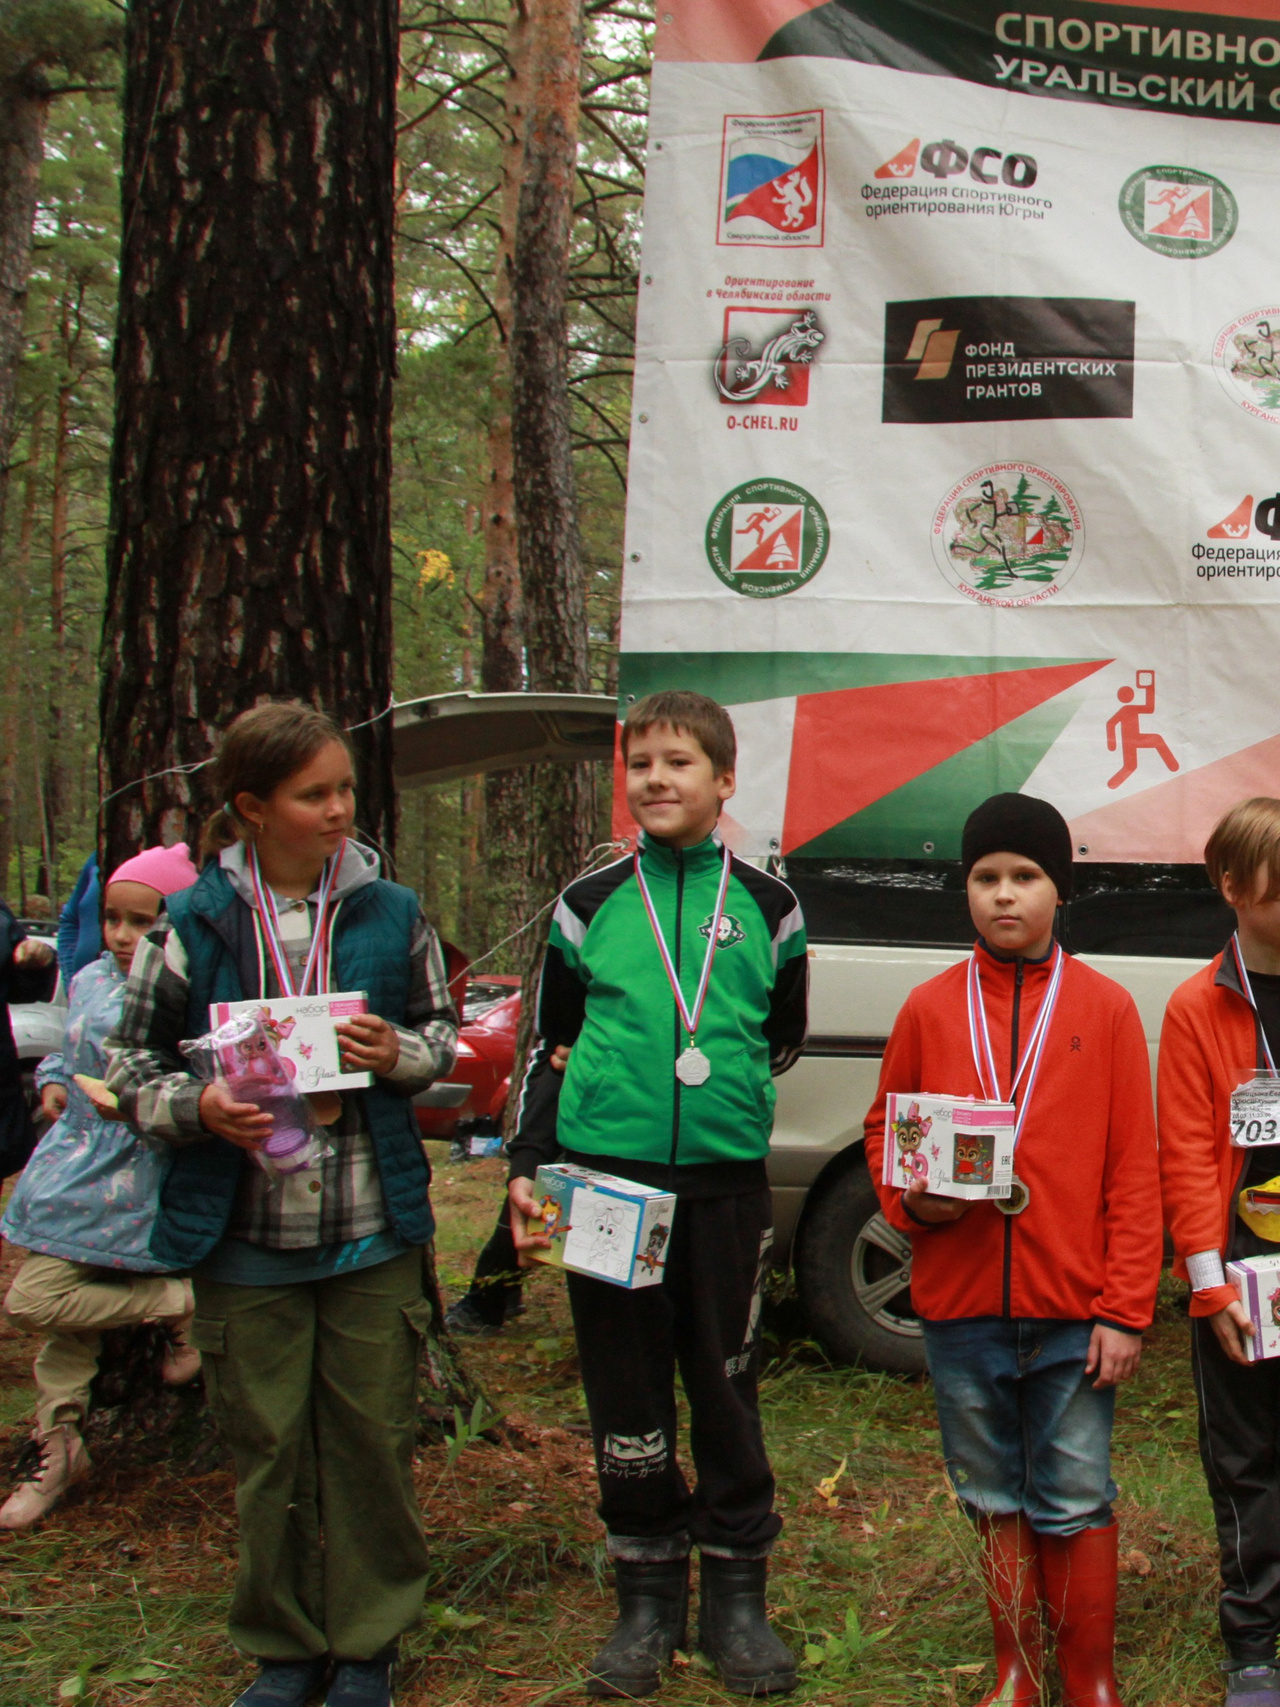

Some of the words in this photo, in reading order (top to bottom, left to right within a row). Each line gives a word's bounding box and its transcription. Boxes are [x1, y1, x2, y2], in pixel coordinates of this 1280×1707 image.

[993, 54, 1254, 111] УРАЛЬСКИЙ
[920, 138, 1038, 189] ФСО
[861, 184, 947, 200] Федерация
[952, 187, 1052, 209] спортивного
[866, 201, 994, 219] ориентирования
[999, 203, 1044, 220] Югры
[725, 276, 816, 289] Ориентирование
[716, 288, 783, 301] Челябинской
[786, 290, 832, 301] области
[965, 342, 1015, 357] ФОНД
[966, 361, 1116, 378] ПРЕЗИДЕНТСКИХ
[966, 382, 1042, 399] ГРАНТОВ
[727, 415, 798, 431] O-CHEL.RU
[745, 483, 807, 503] СПОРТИВНОГО
[934, 485, 964, 535] ФЕДЕРАЦИЯ
[962, 463, 1025, 487] СПОРТИВНОГО
[1026, 465, 1081, 531] ОРИЕНТИРОВАНИЯ
[957, 582, 1014, 608] КУРГАНСКОЙ
[1016, 584, 1060, 607] ОБЛАСТИ
[296, 1003, 328, 1014] набор
[1232, 1119, 1277, 1142] 703
